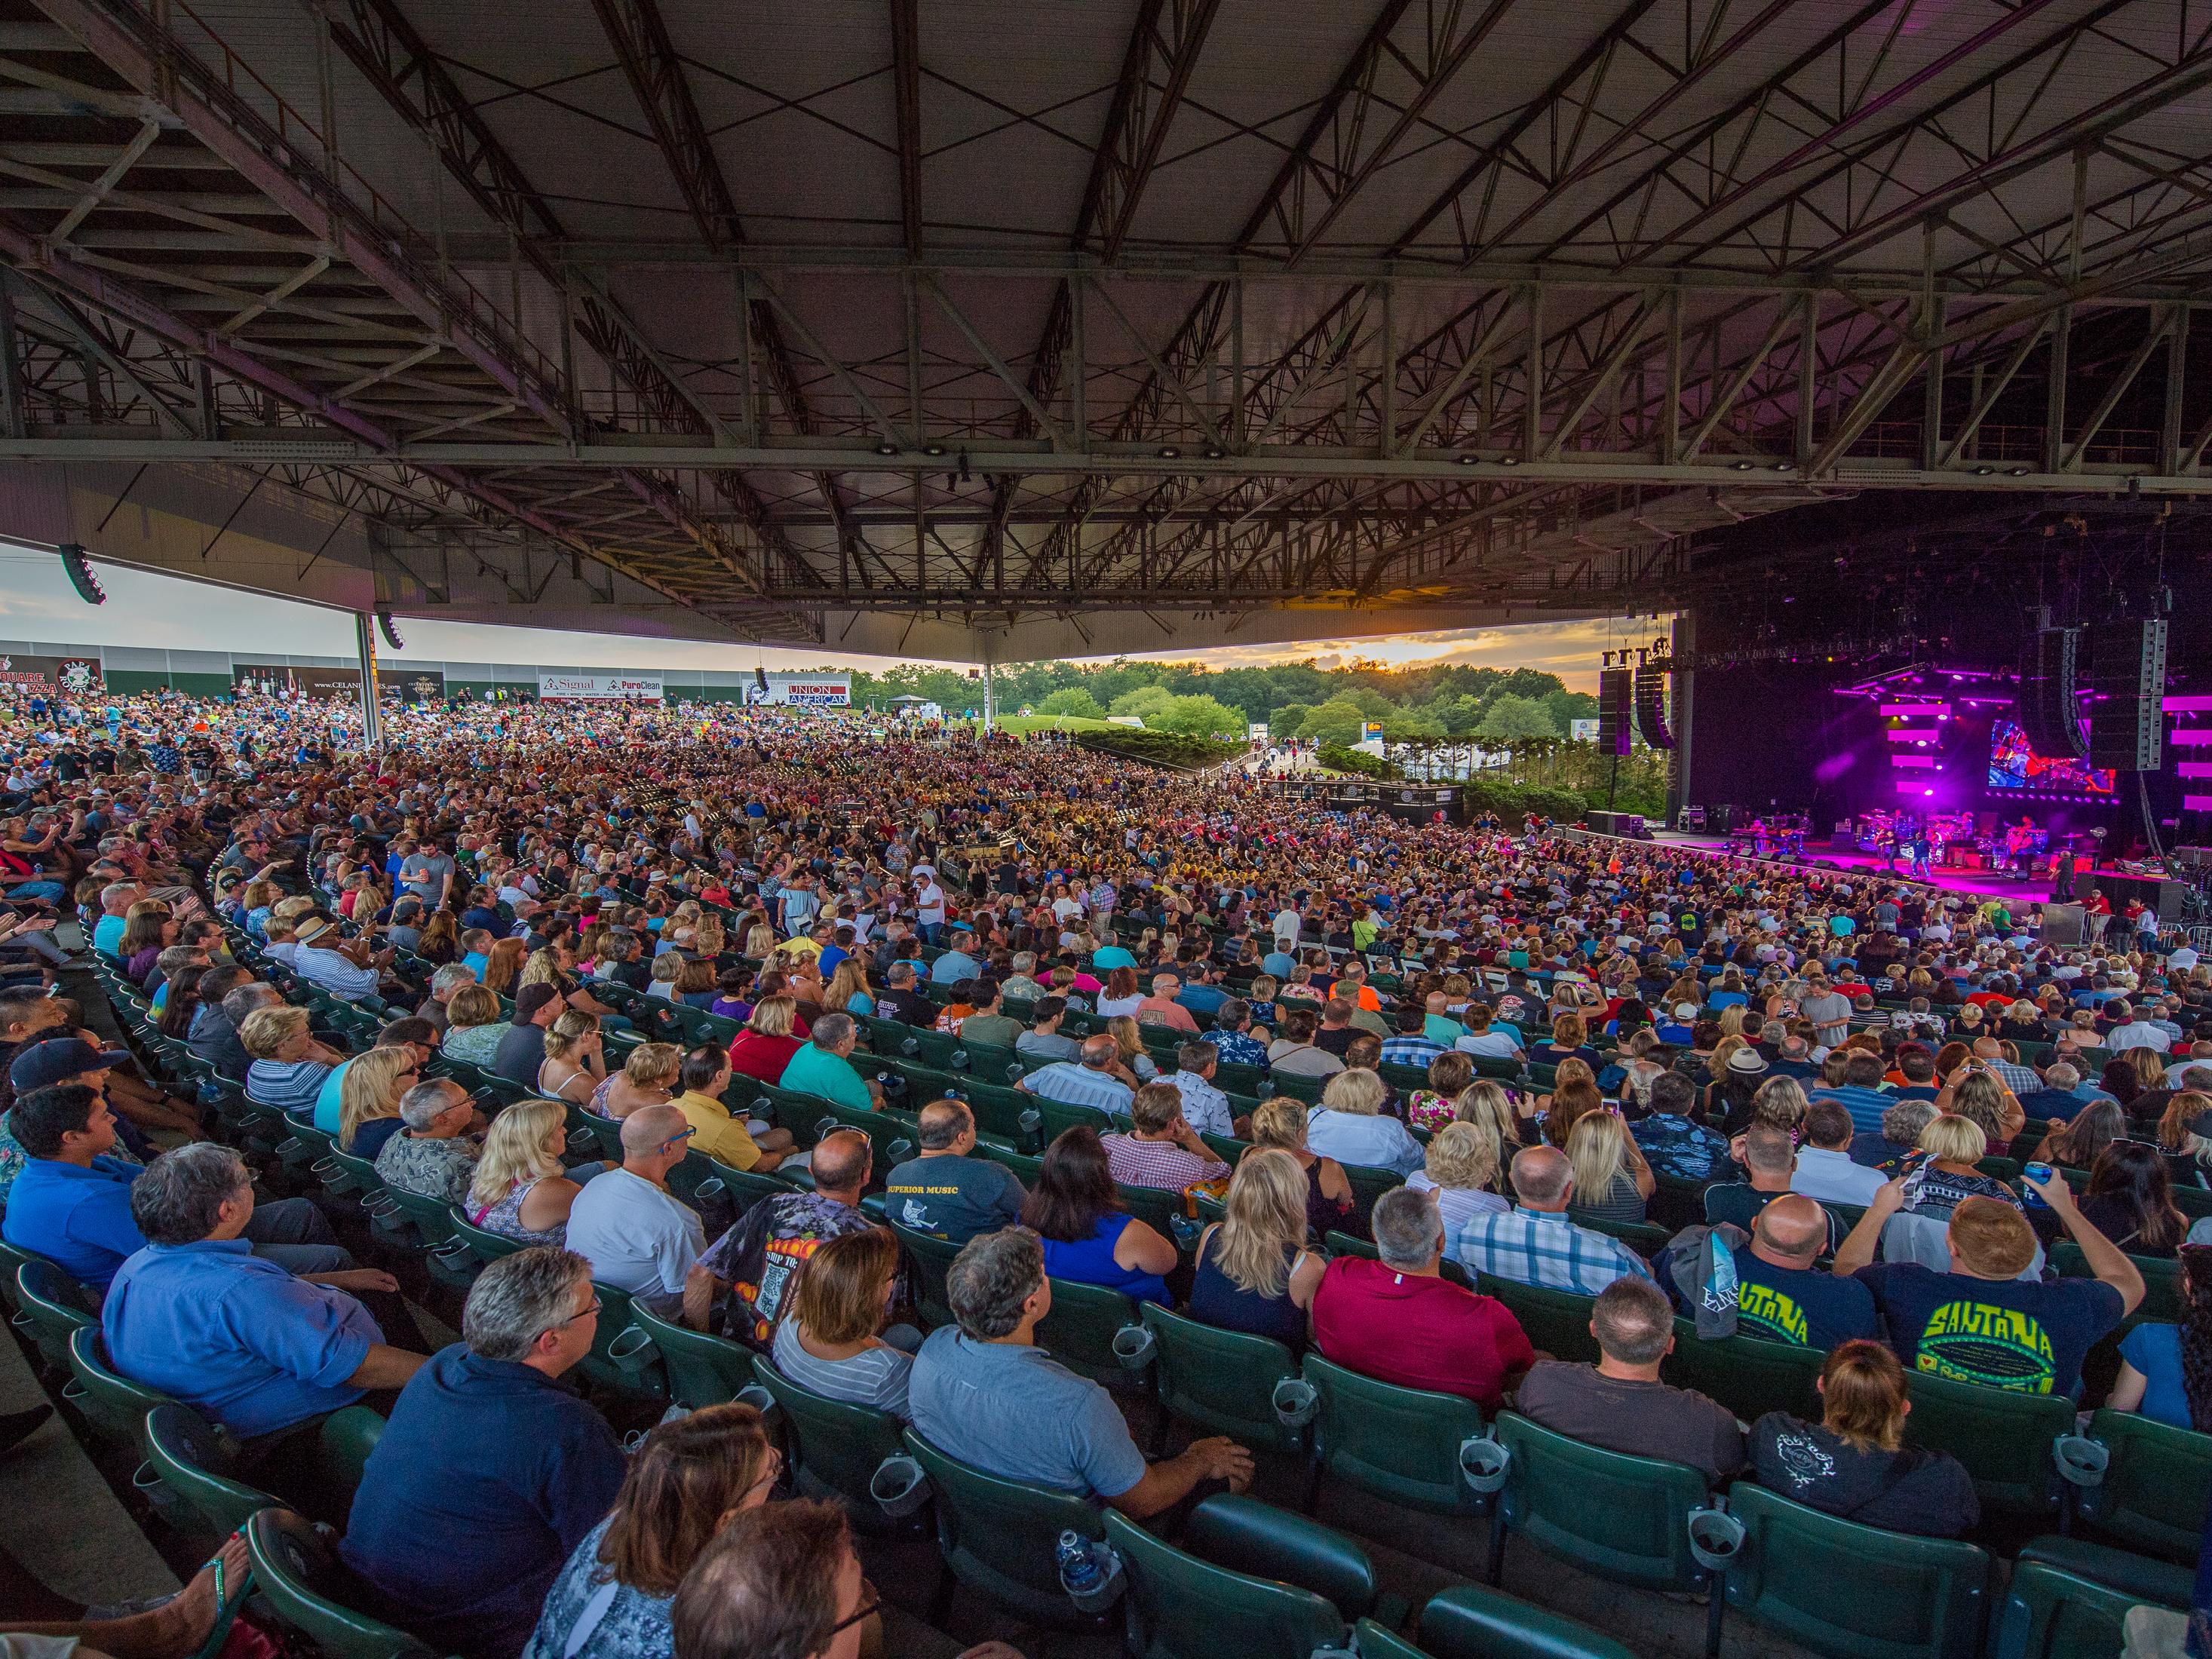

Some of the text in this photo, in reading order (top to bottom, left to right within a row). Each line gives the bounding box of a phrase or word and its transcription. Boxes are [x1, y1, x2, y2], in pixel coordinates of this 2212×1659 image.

[64, 661, 91, 671] PAPA
[26, 682, 58, 693] IZZA
[559, 679, 660, 692] Signal PuroClean
[790, 695, 846, 704] AMERICAN
[926, 1186, 959, 1194] MUSIC
[766, 1252, 798, 1269] SHIP TO:
[1923, 1301, 2055, 1362] SANTANA
